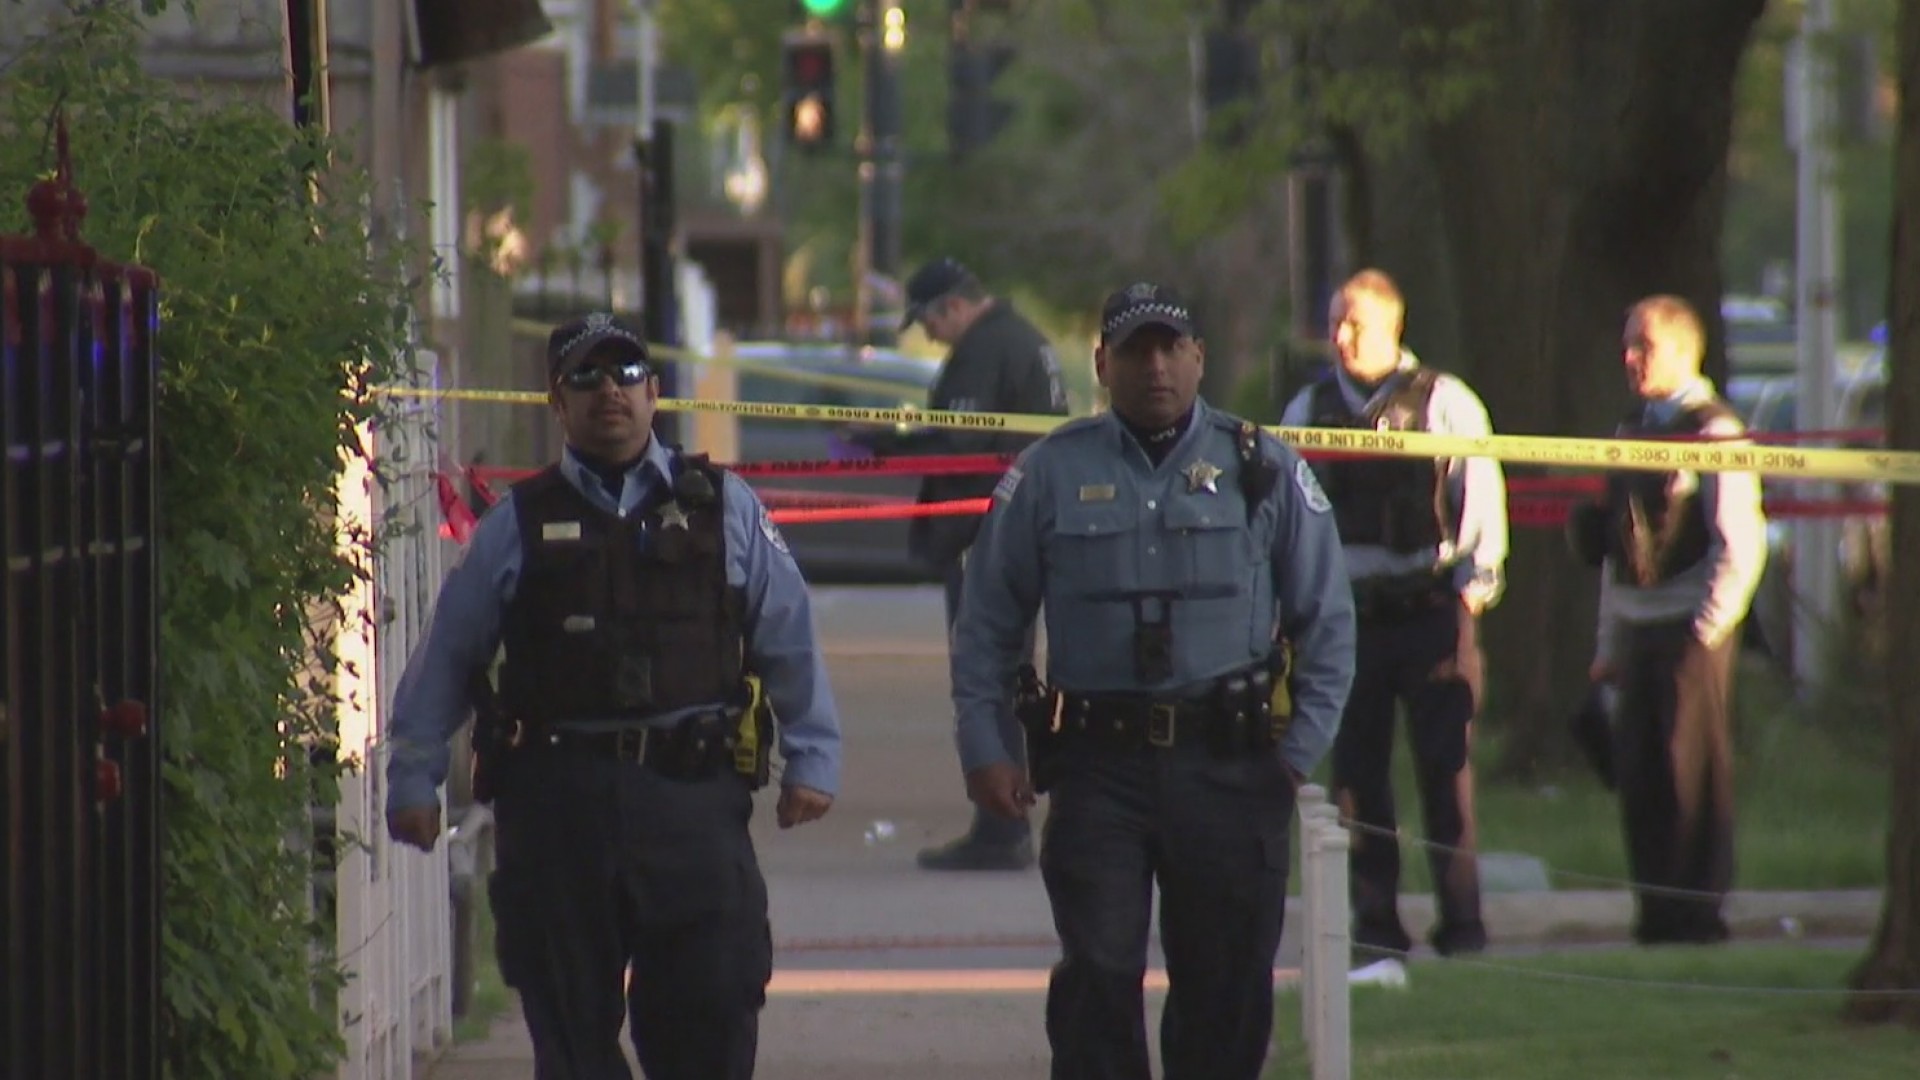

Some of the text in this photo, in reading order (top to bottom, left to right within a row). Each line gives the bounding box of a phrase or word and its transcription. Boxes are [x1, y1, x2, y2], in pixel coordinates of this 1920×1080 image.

[1304, 431, 1322, 444] DO
[1327, 432, 1355, 447] LINE
[1362, 435, 1405, 449] POLICE
[1704, 451, 1722, 464] DO
